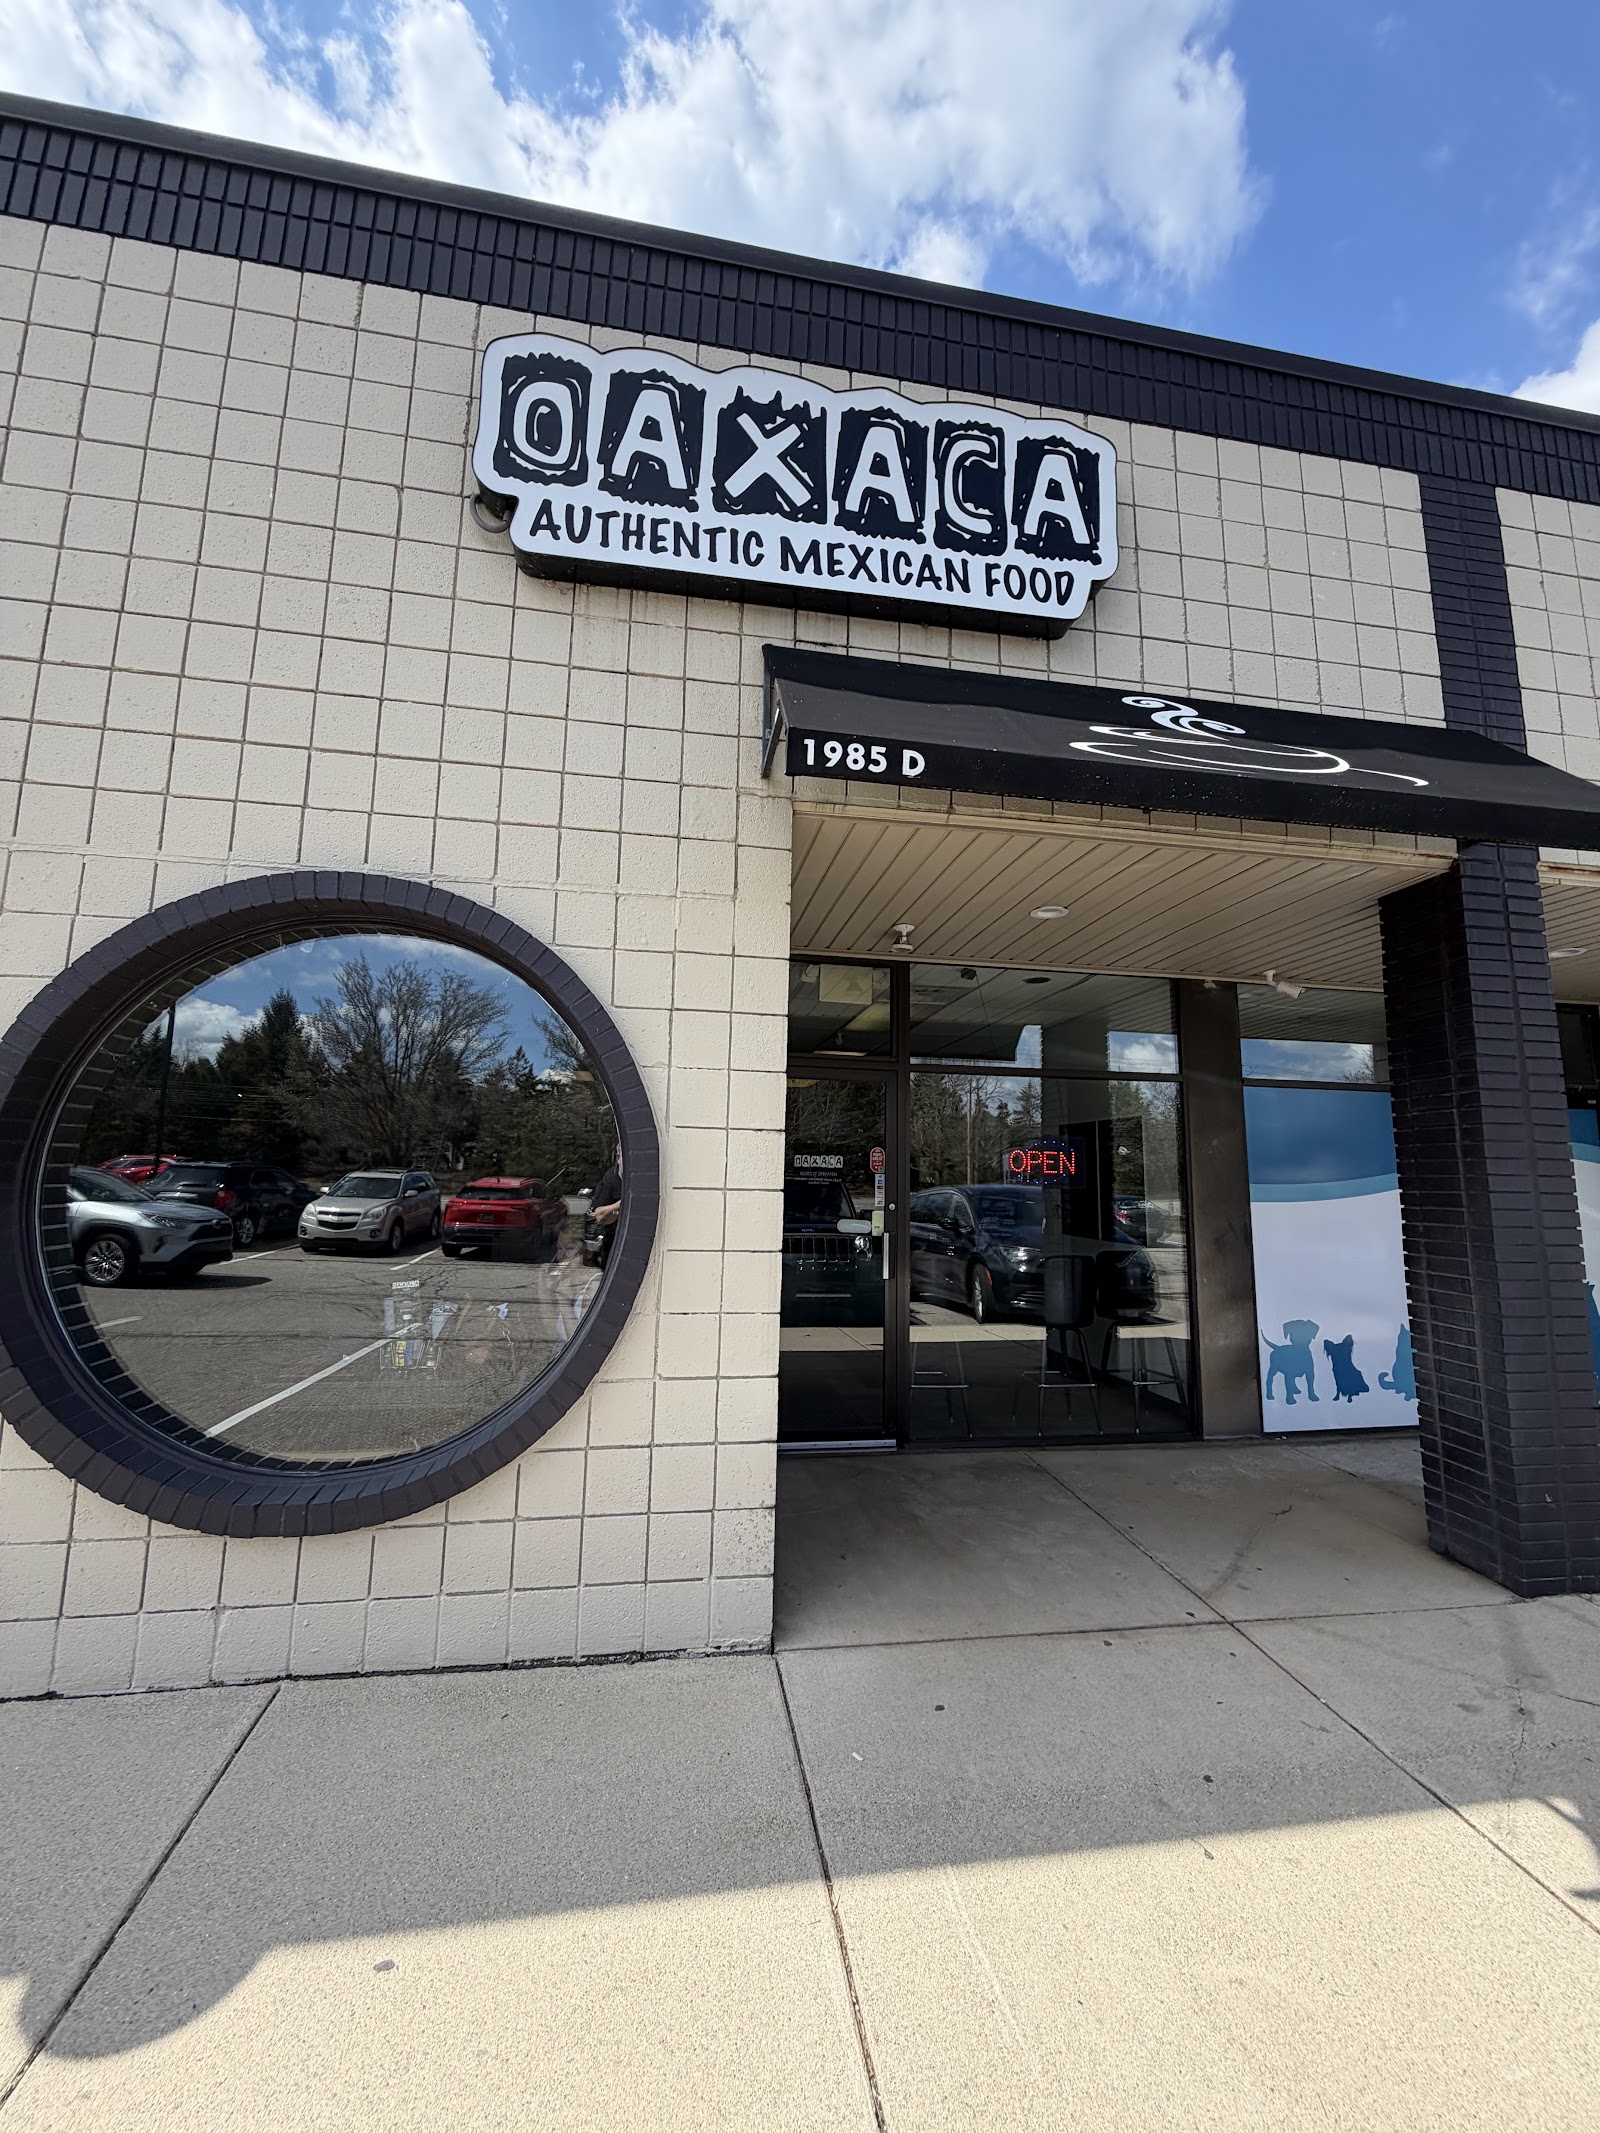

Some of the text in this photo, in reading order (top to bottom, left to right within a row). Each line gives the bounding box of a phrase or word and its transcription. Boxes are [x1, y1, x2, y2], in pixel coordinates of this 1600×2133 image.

[493, 352, 1101, 565] OAXACA
[529, 499, 1075, 604] AUTHENTIC MEXICAN FOOD
[803, 738, 925, 776] 1985 D
[793, 1154, 843, 1168] OAXACA
[1009, 1149, 1075, 1174] OPEN
